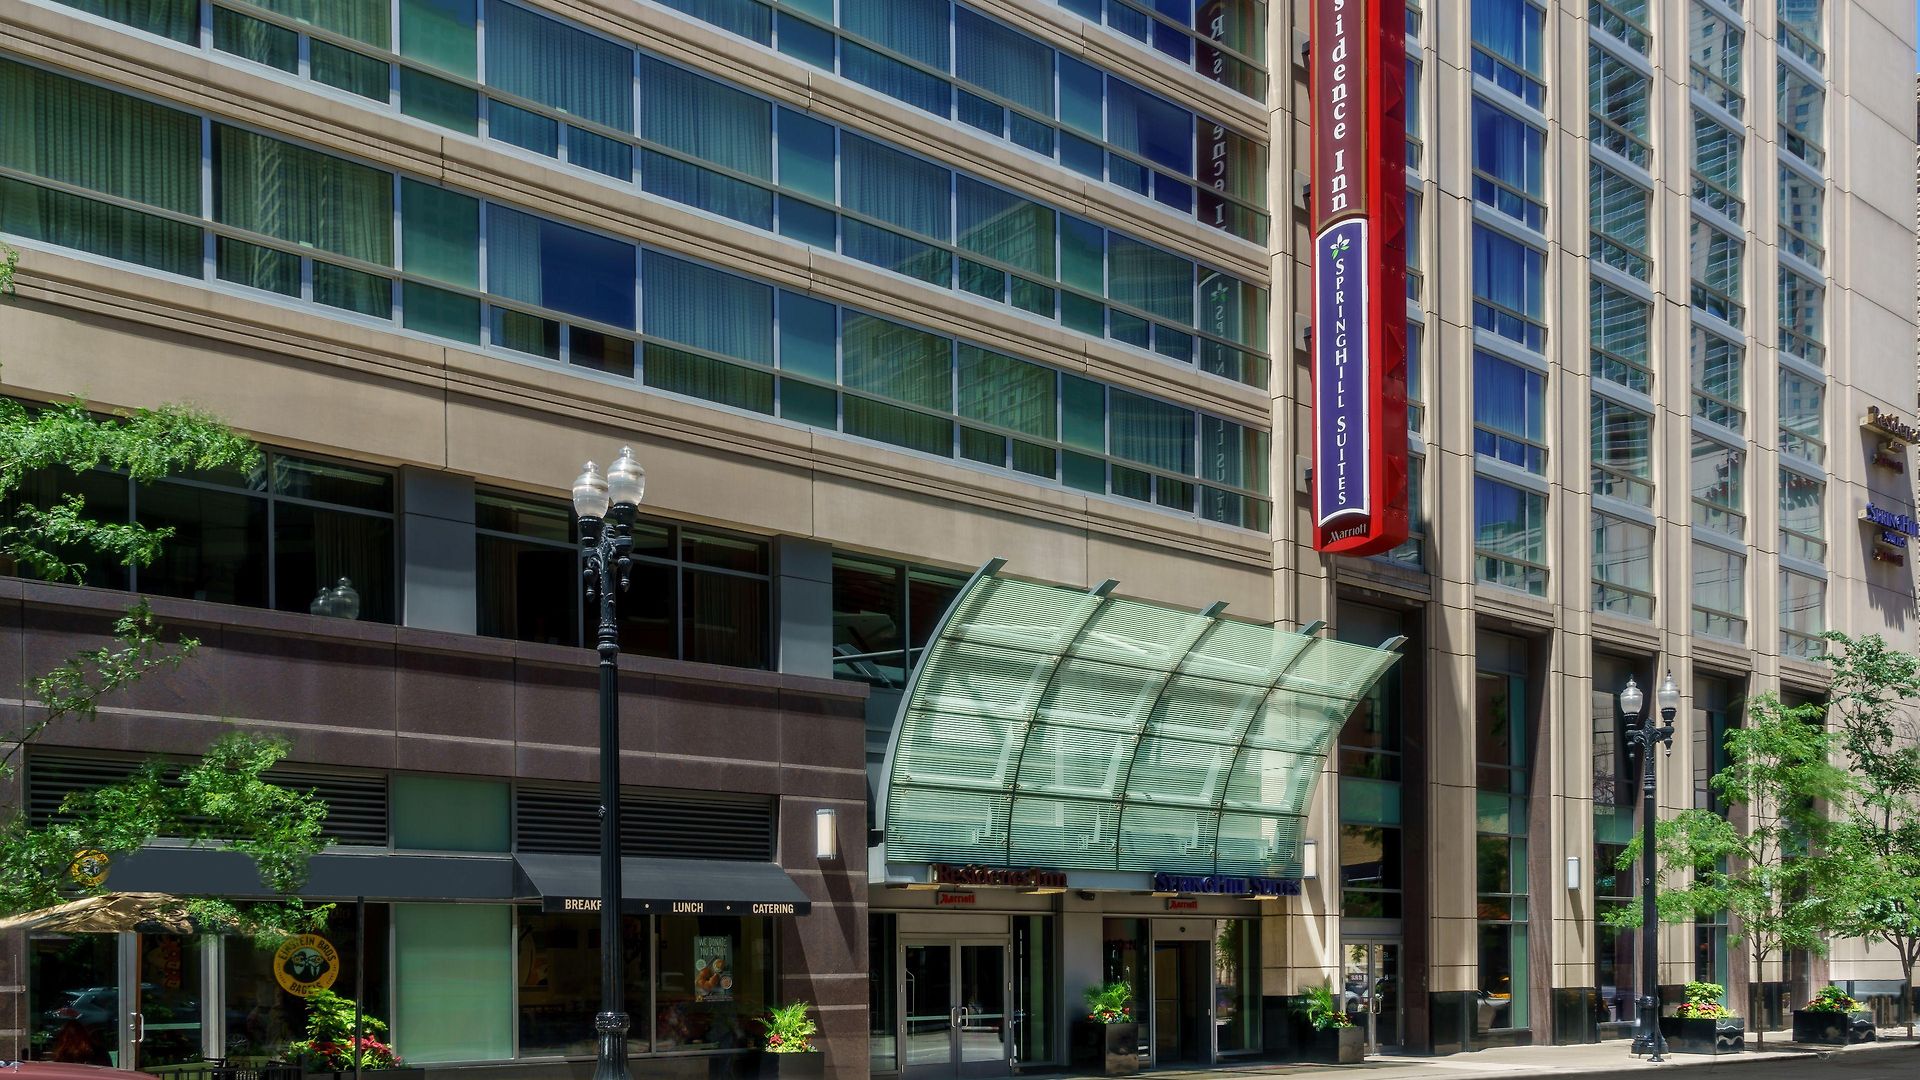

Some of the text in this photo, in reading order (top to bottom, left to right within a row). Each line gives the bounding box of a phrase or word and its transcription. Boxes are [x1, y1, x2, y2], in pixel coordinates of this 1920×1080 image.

[1331, 149, 1348, 213] Inn
[1335, 258, 1348, 506] SPRINGHILL SUITES
[1328, 523, 1367, 543] Marriott
[1031, 867, 1067, 888] Inn
[1249, 876, 1301, 896] SUITES
[672, 902, 704, 914] LUNCH
[752, 903, 794, 915] CATERING
[319, 941, 336, 961] BROS
